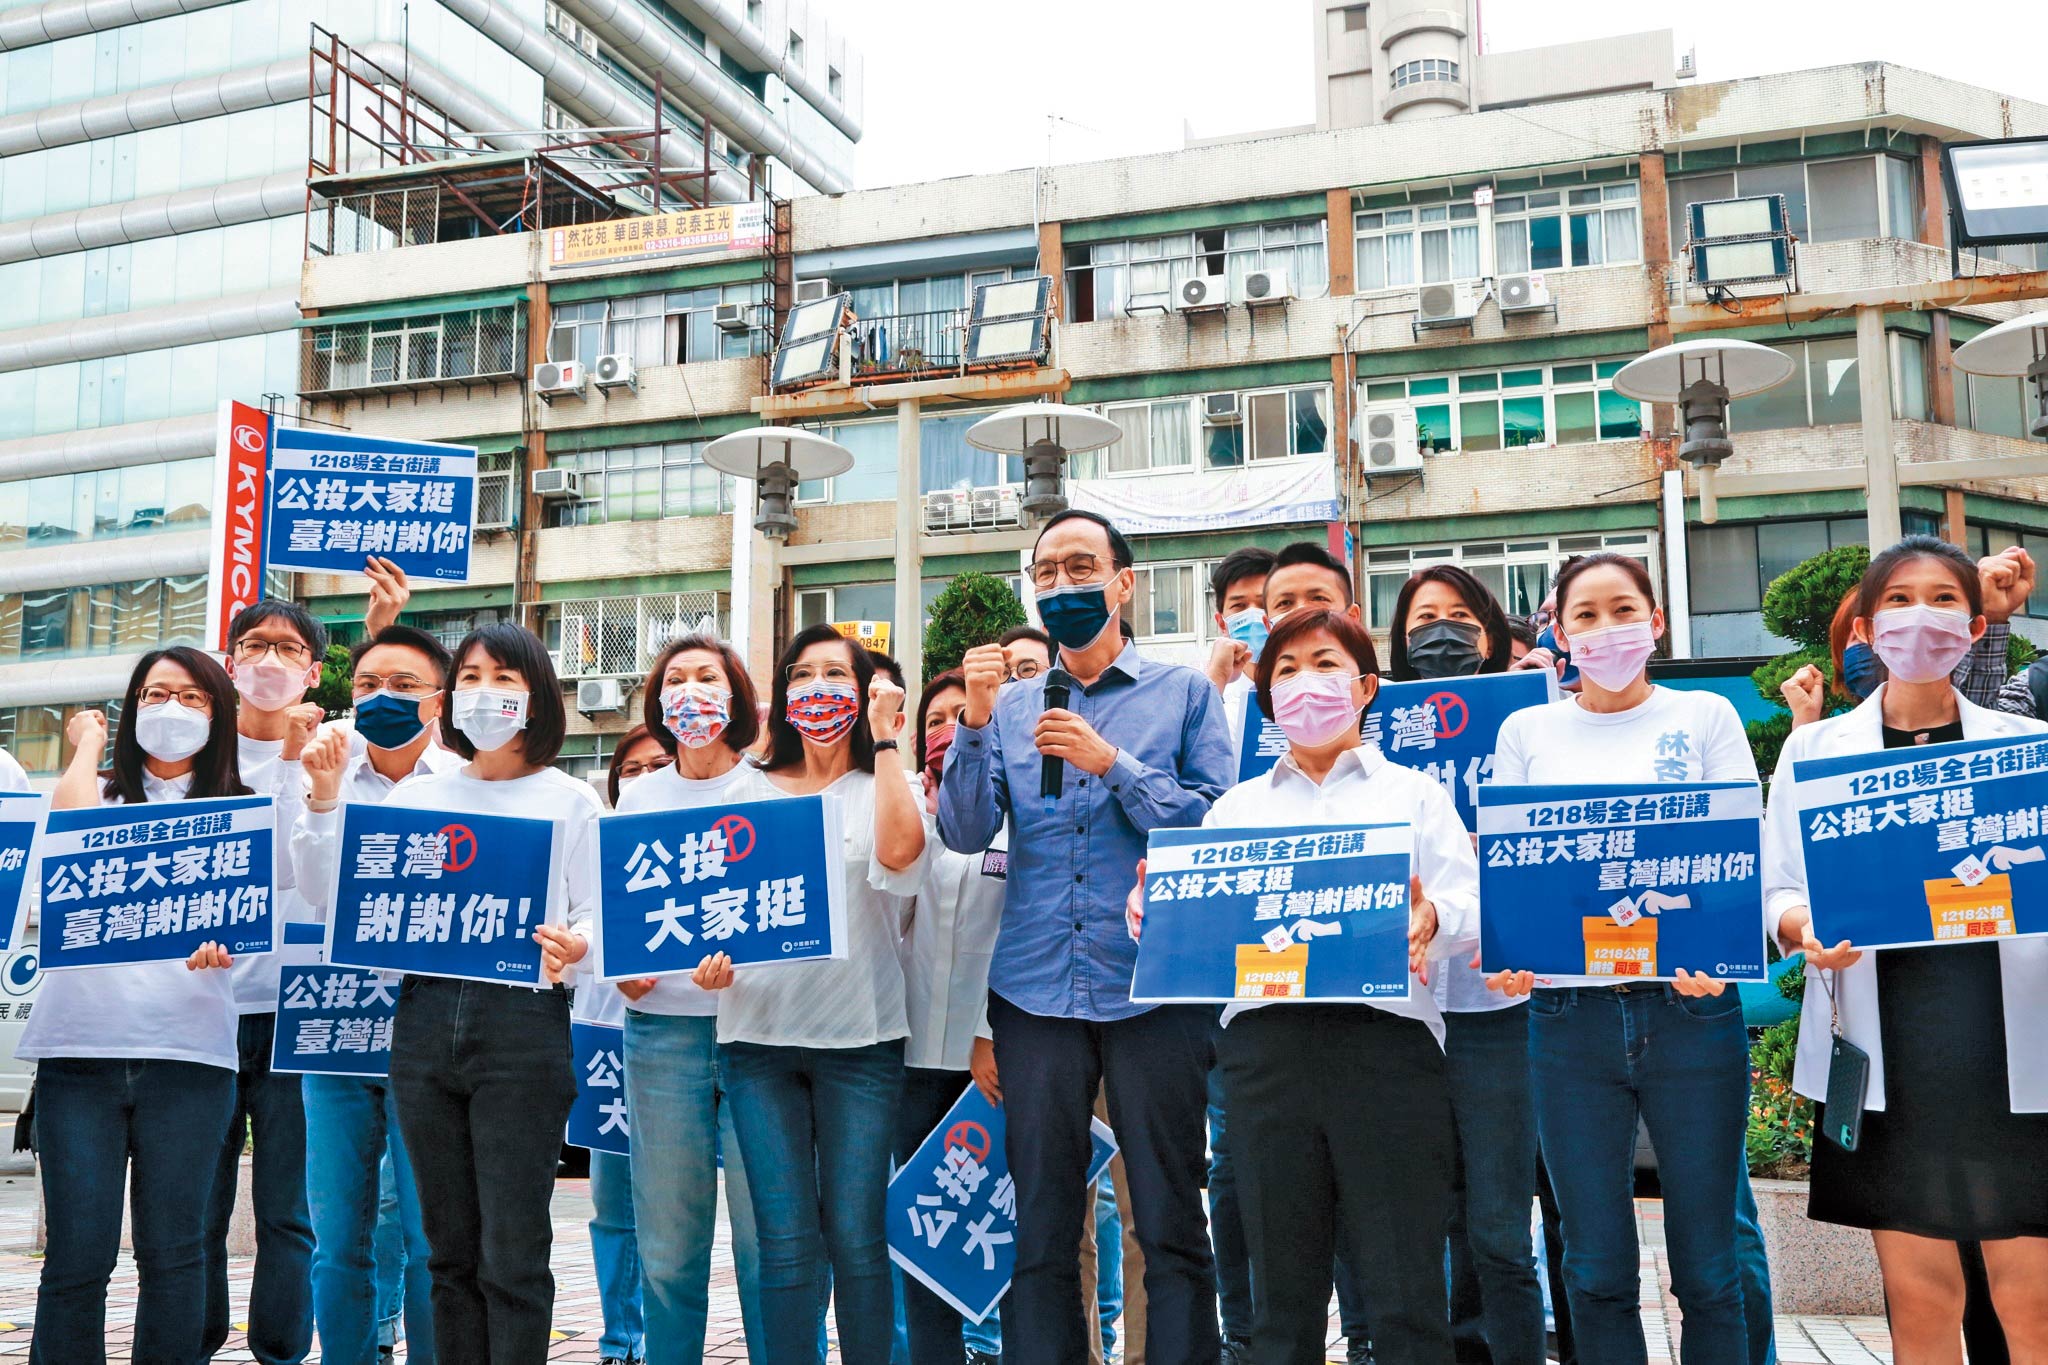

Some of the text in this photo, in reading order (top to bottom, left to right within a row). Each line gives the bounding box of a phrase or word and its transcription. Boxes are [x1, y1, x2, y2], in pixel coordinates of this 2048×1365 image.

[310, 454, 441, 474] 1218場全台街講
[277, 477, 455, 514] 公投大家挺
[288, 519, 468, 554] 臺灣謝謝你
[843, 624, 872, 636] 出租
[1526, 793, 1711, 827] 1218場全台街講
[1809, 787, 1975, 842] 公投大家挺
[1936, 805, 2048, 853] 臺灣謝
[81, 813, 233, 848] 1218場全台街講
[1191, 832, 1366, 865] 1218場全台街講
[1486, 829, 1636, 869] 公投大家挺
[46, 838, 251, 903] 公投大家挺
[354, 832, 449, 879] 臺灣
[624, 829, 728, 893] 公投
[1598, 851, 1755, 891] 臺灣謝謝你
[1148, 865, 1294, 903] 公投大家挺
[1254, 882, 1405, 921] 臺灣謝謝你
[60, 885, 269, 950] 臺灣謝謝你
[355, 892, 532, 943] 謝謝你!
[644, 874, 807, 953] 大家挺
[1941, 905, 2005, 922] 1218公投
[1594, 947, 1650, 961] 1218公投
[283, 973, 402, 1010] 公投大
[1245, 971, 1299, 983] 1218公投
[907, 1146, 989, 1249] 公投
